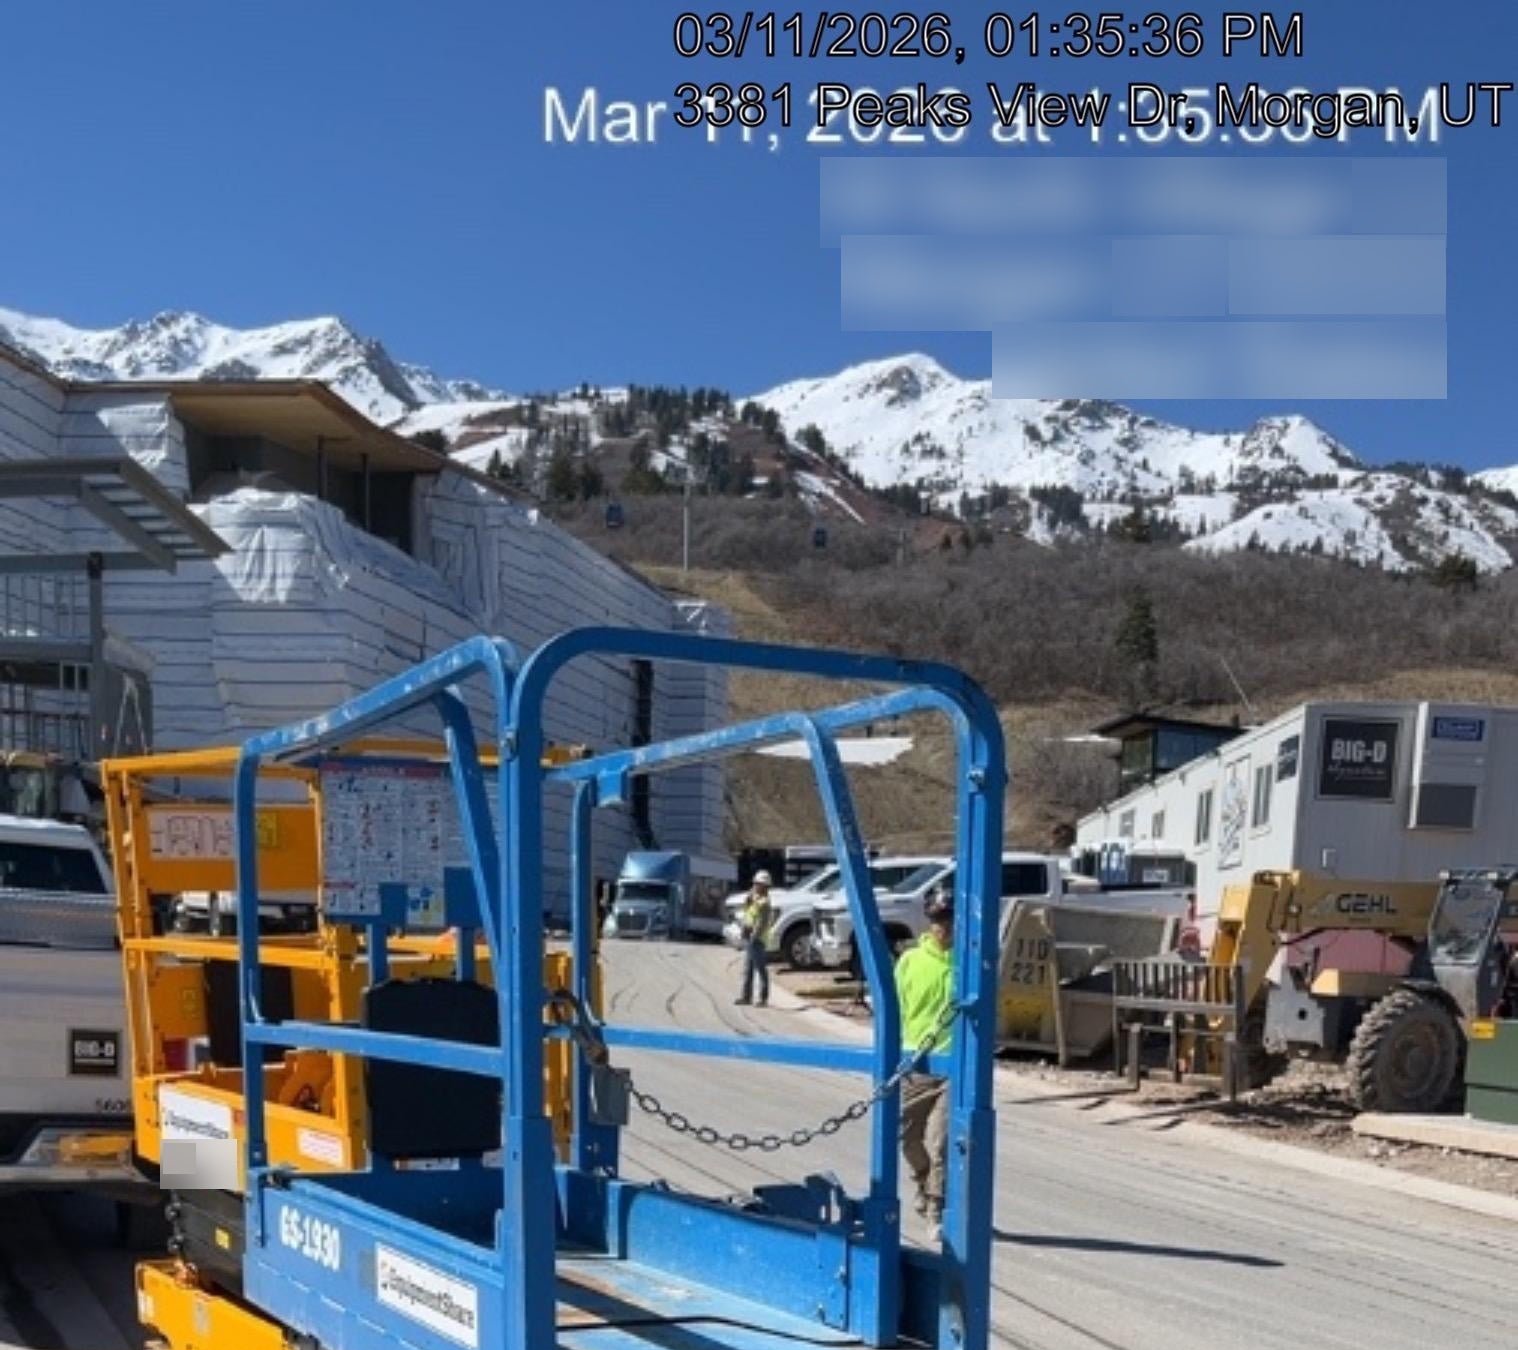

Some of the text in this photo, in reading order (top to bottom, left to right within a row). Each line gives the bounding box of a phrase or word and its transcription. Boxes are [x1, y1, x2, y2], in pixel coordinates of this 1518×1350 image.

[1331, 738, 1387, 763] BIG-D
[1336, 893, 1397, 913] GEHL
[279, 1205, 340, 1272] GS-1930
[389, 1265, 475, 1329] EquipmentShare
